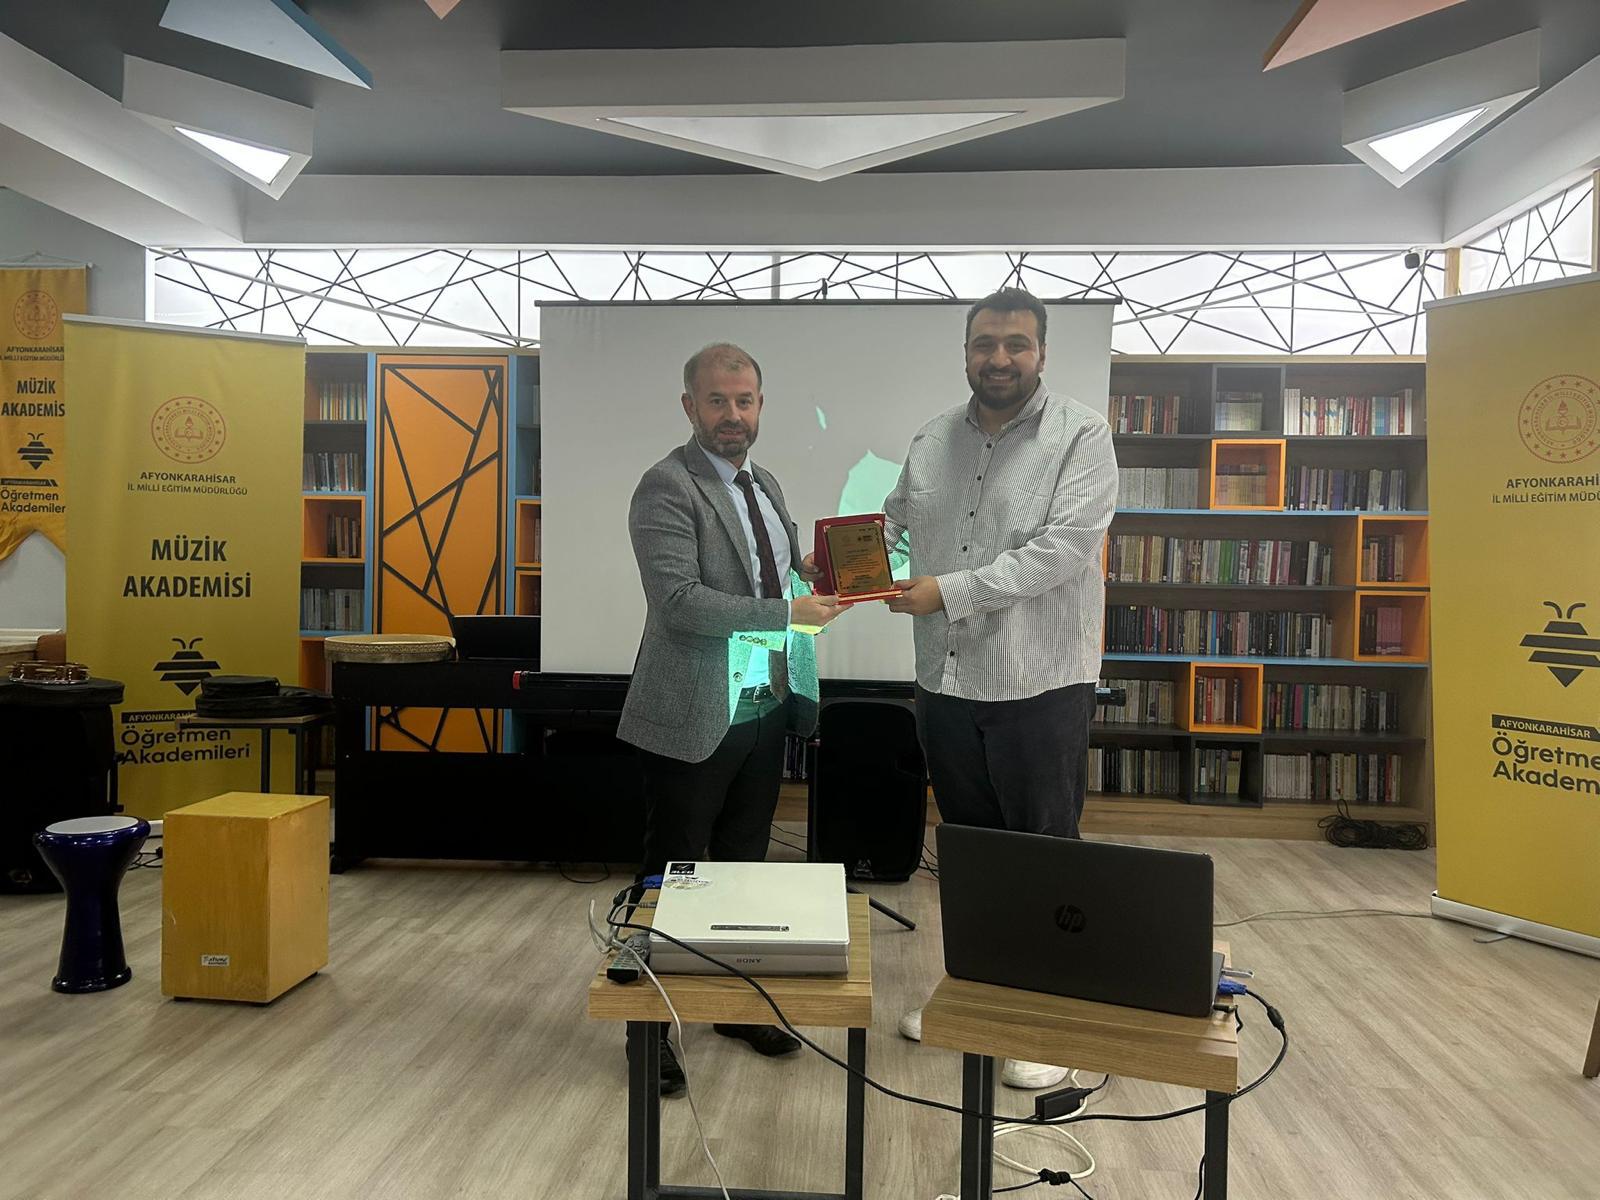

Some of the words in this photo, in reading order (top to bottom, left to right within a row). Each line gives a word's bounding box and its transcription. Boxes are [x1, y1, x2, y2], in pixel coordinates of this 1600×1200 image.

[16, 377, 56, 394] MÜZİK
[1, 400, 65, 416] AKADEMİS
[140, 471, 236, 484] AFYONKARAHİSAR
[1506, 473, 1600, 489] AFYONKARAHİ
[0, 486, 59, 502] Öğretmen
[127, 482, 135, 491] İL
[137, 482, 160, 492] MİLLİ
[161, 483, 191, 493] EĞİTİM
[193, 484, 248, 496] MÜDÜRLÜĞÜ
[1492, 493, 1501, 504] İL
[1502, 492, 1529, 503] MİLLİ
[1531, 491, 1567, 503] EĞİTİM
[1, 502, 66, 513] Akademiler
[151, 534, 227, 562] MÜZİK
[122, 571, 251, 598] AKADEMİSİ
[120, 724, 231, 749] Öğretmen
[1499, 719, 1591, 739] AFYONKARAHİSAR
[120, 743, 250, 765] Akademileri
[1492, 731, 1600, 770] Öğretme
[1492, 760, 1600, 795] Akadem
[1057, 904, 1084, 932] hp
